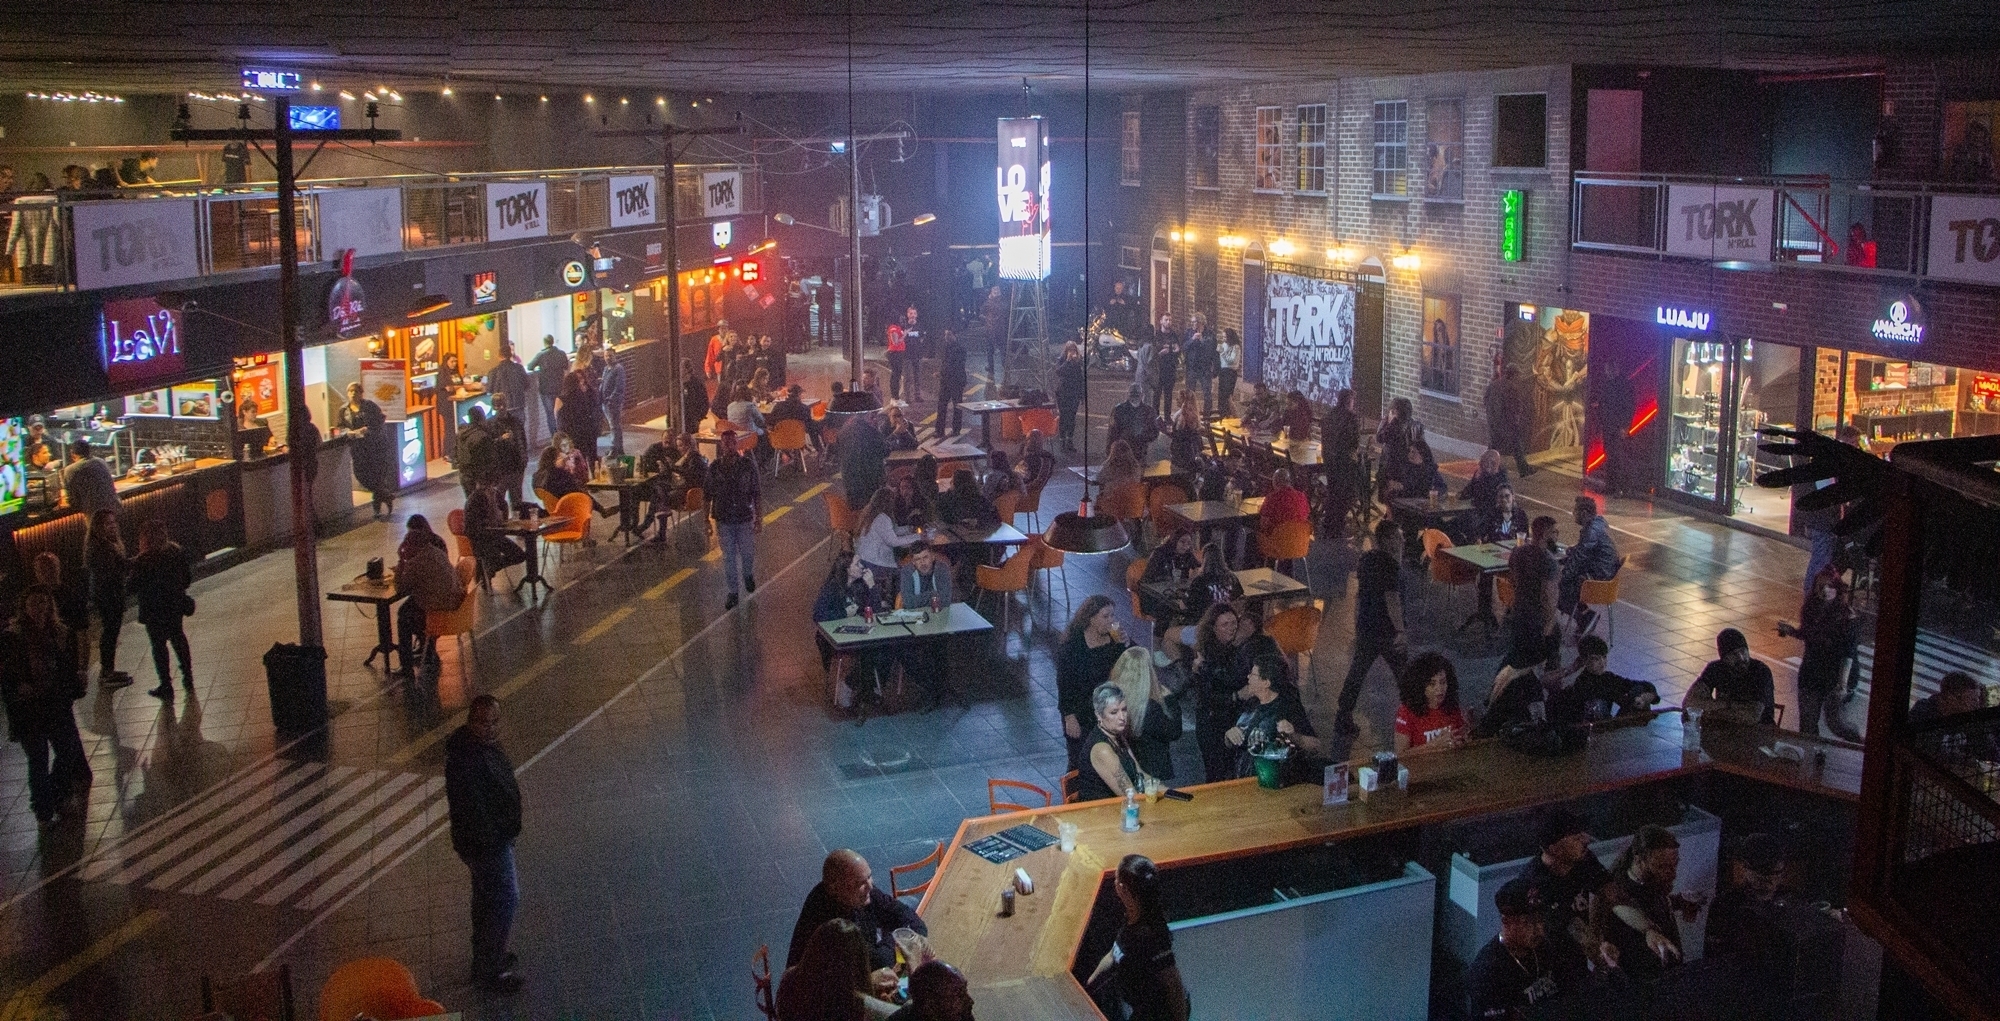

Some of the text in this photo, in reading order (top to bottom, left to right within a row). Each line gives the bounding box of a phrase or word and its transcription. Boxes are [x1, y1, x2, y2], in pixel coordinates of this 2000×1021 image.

[709, 177, 735, 208] TORK
[997, 164, 1026, 192] LO
[495, 188, 539, 230] TORK
[616, 182, 649, 217] TORK
[1680, 197, 1759, 241] TORK
[1727, 238, 1756, 249] N'ROLL
[1270, 293, 1345, 346] TORK
[1657, 306, 1710, 331] LUAJU
[1315, 347, 1344, 362] N'ROLL
